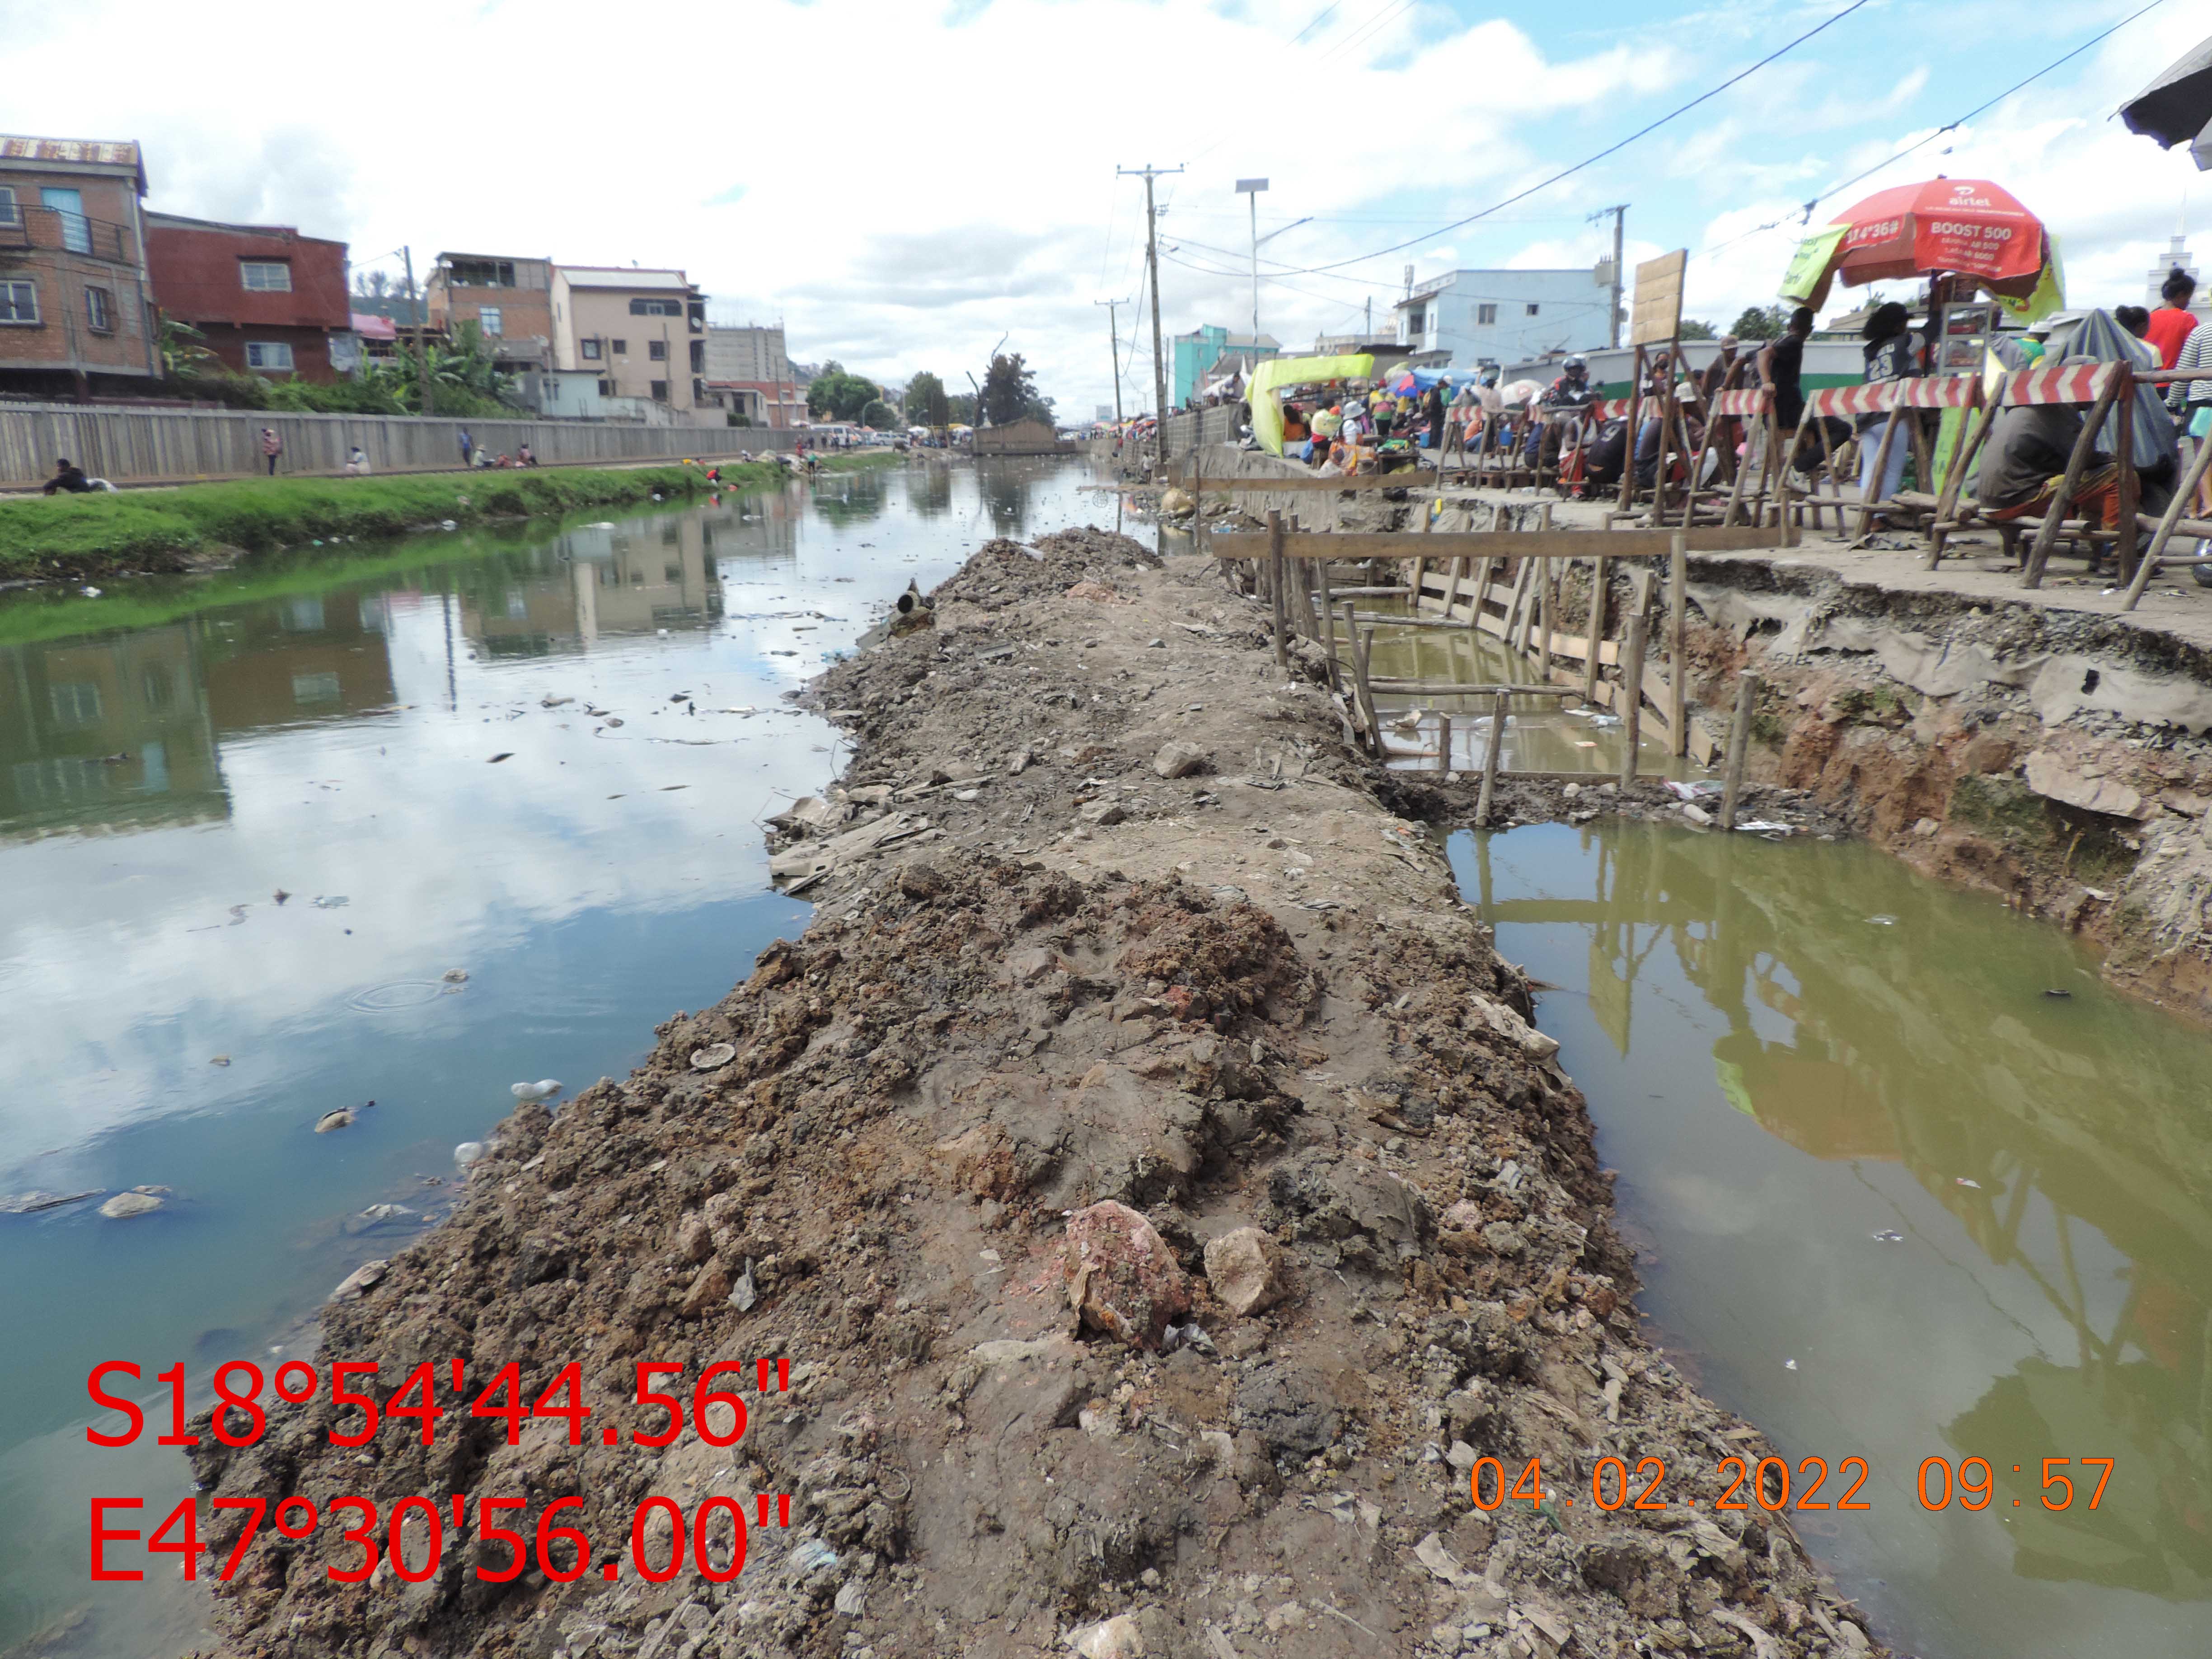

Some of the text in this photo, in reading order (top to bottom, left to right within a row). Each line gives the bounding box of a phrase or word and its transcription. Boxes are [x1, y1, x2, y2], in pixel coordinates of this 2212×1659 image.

[1949, 196, 1992, 206] airtel
[1931, 221, 2012, 240] BOOST 500
[1869, 354, 1893, 381] 23
[1601, 425, 1621, 442] 9
